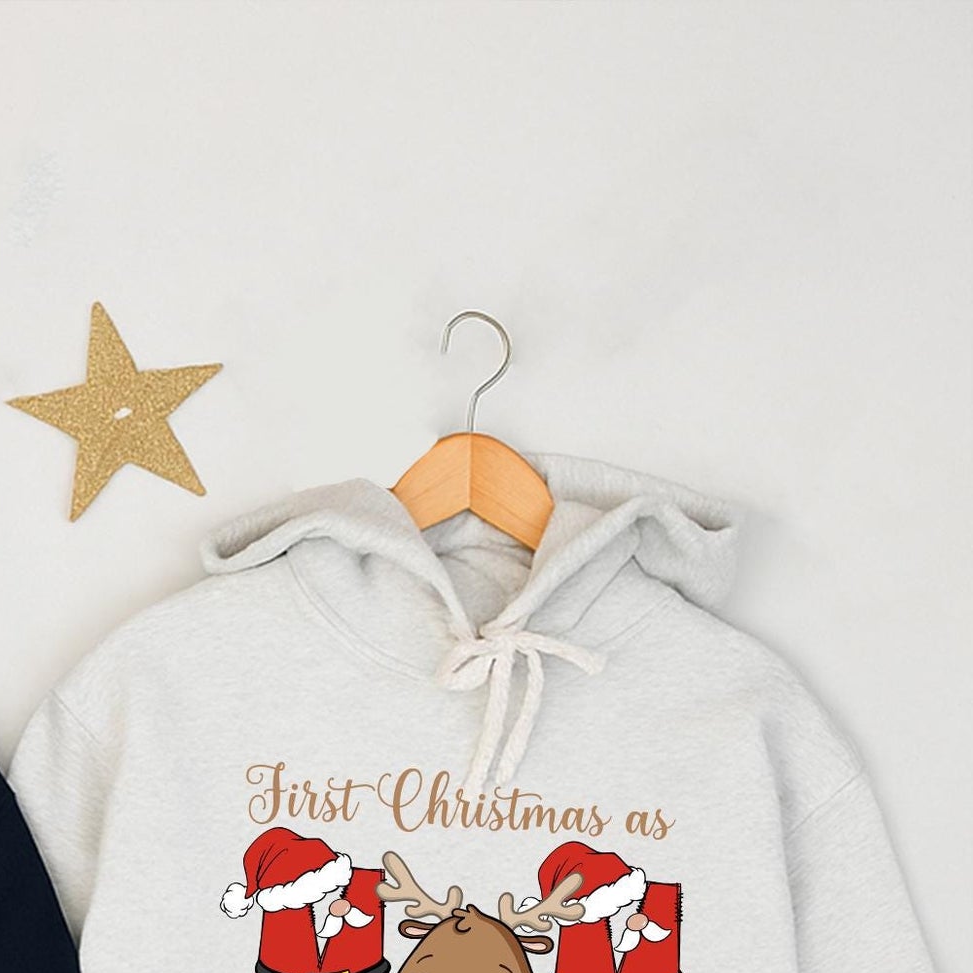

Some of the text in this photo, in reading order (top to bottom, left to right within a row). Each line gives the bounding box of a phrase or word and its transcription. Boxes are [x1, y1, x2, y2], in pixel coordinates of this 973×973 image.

[246, 762, 677, 841] First Christmas as
